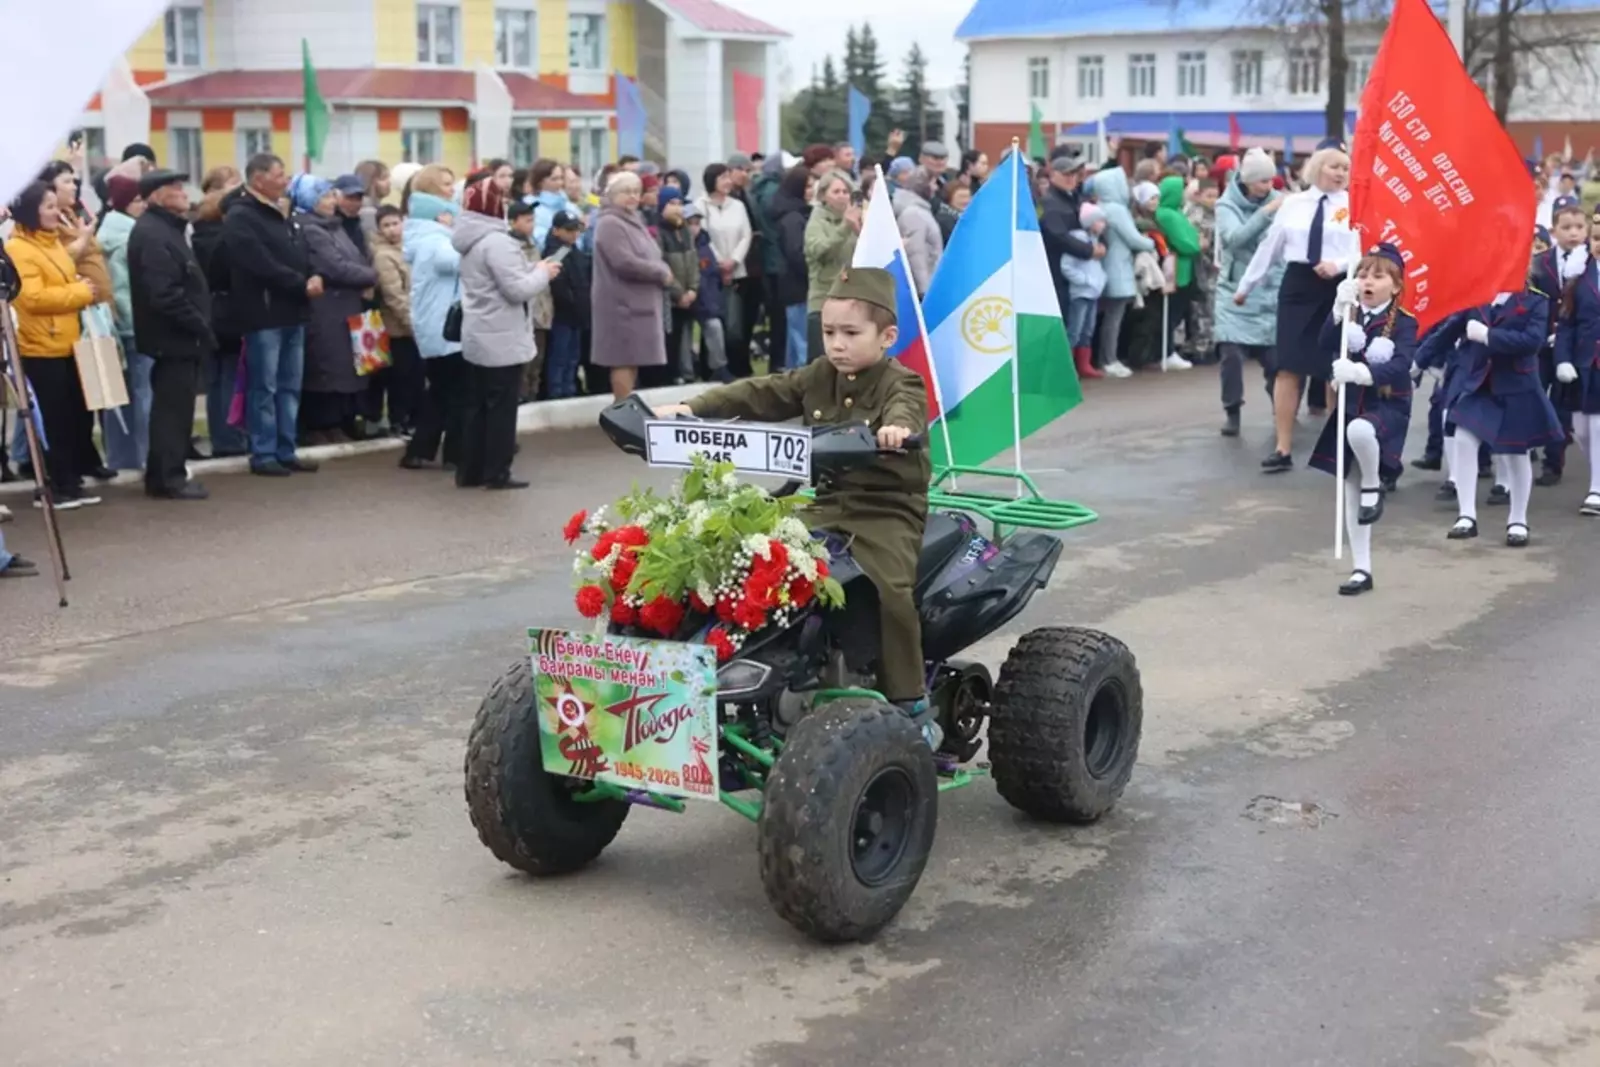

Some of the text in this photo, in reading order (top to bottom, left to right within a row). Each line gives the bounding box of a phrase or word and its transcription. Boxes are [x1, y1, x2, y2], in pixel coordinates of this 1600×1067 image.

[1387, 90, 1416, 120] 150
[1432, 152, 1475, 205] ОРДЕНА
[675, 429, 748, 449] ПОБЕДА
[771, 435, 805, 462] 702
[604, 690, 694, 753] Победа
